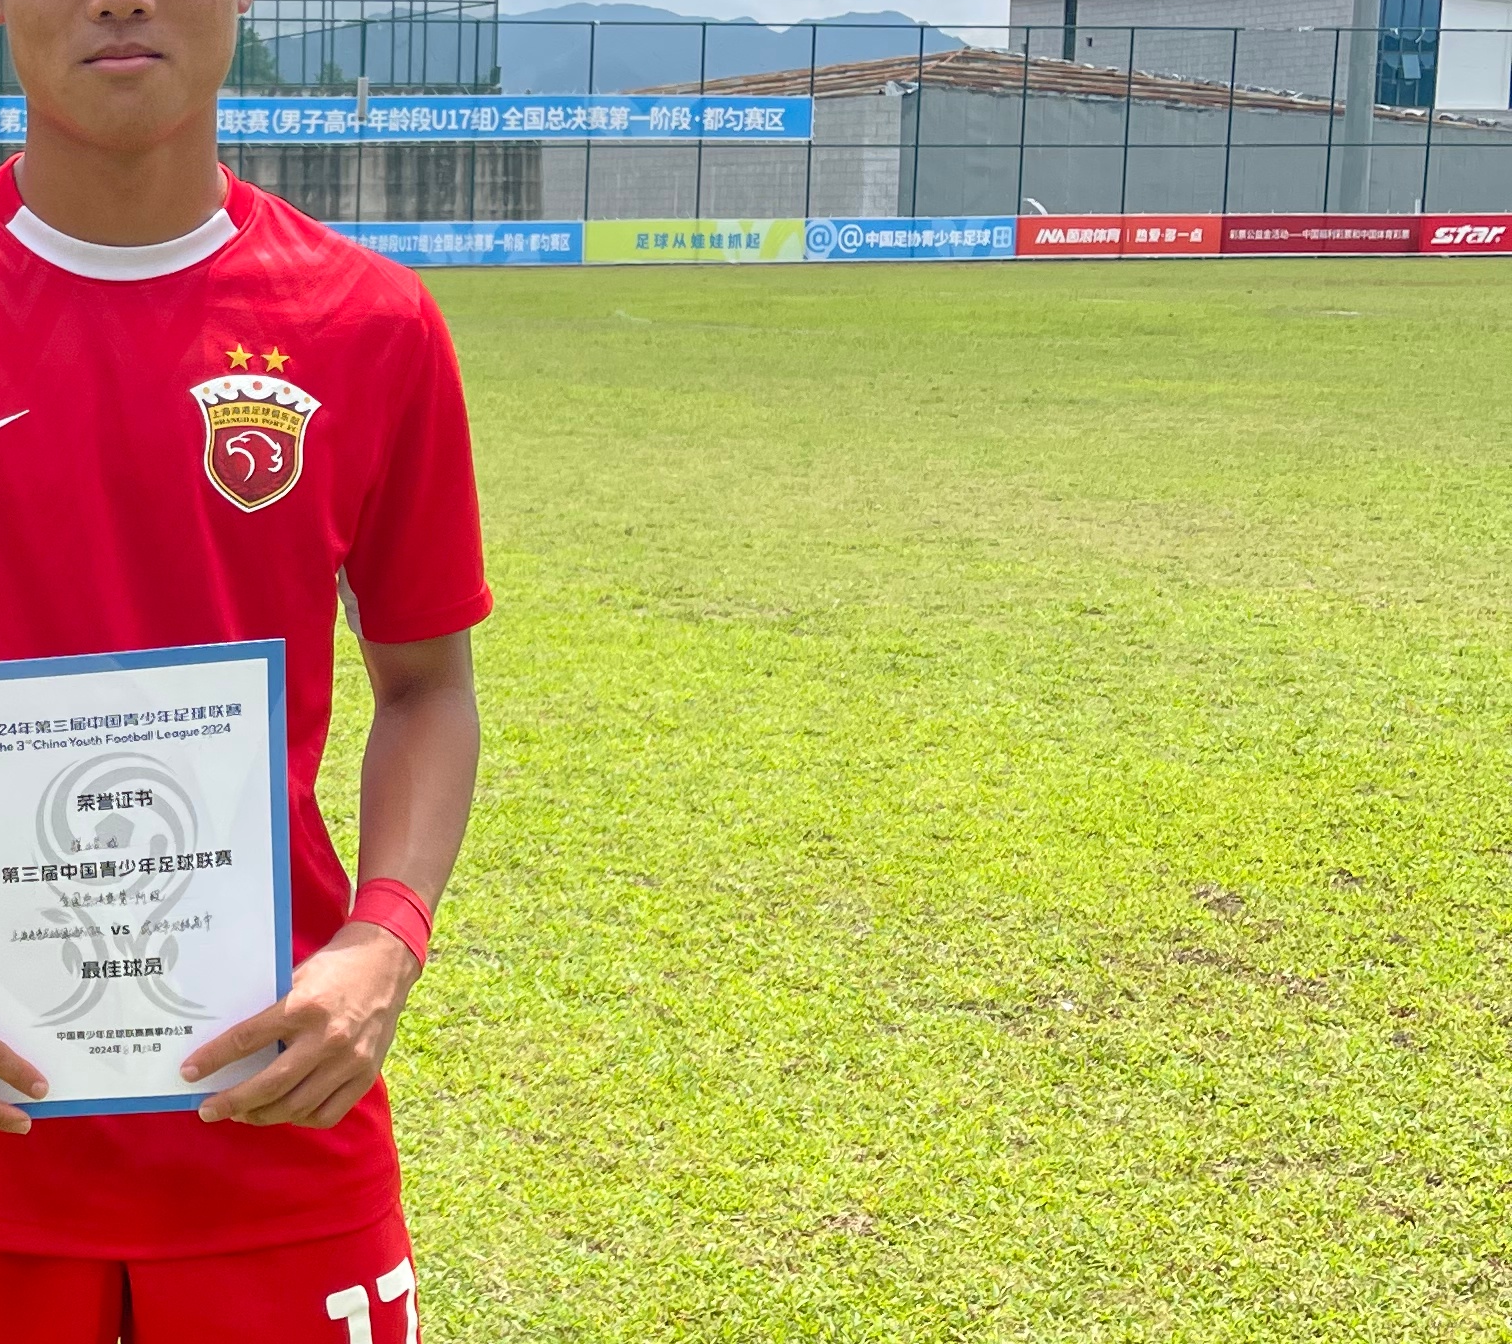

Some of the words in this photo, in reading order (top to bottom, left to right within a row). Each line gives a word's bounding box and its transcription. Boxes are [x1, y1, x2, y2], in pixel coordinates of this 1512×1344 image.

[635, 233, 761, 250] 足球从娃娃抓起
[33, 739, 68, 750] China
[68, 736, 103, 748] Youth
[105, 730, 154, 744] Football
[156, 727, 200, 740] League
[201, 723, 231, 736] 2024
[76, 788, 153, 812] 荣誉证书
[1, 849, 233, 884] 第三届中国青少年足球联赛
[81, 957, 163, 980] 最佳球员
